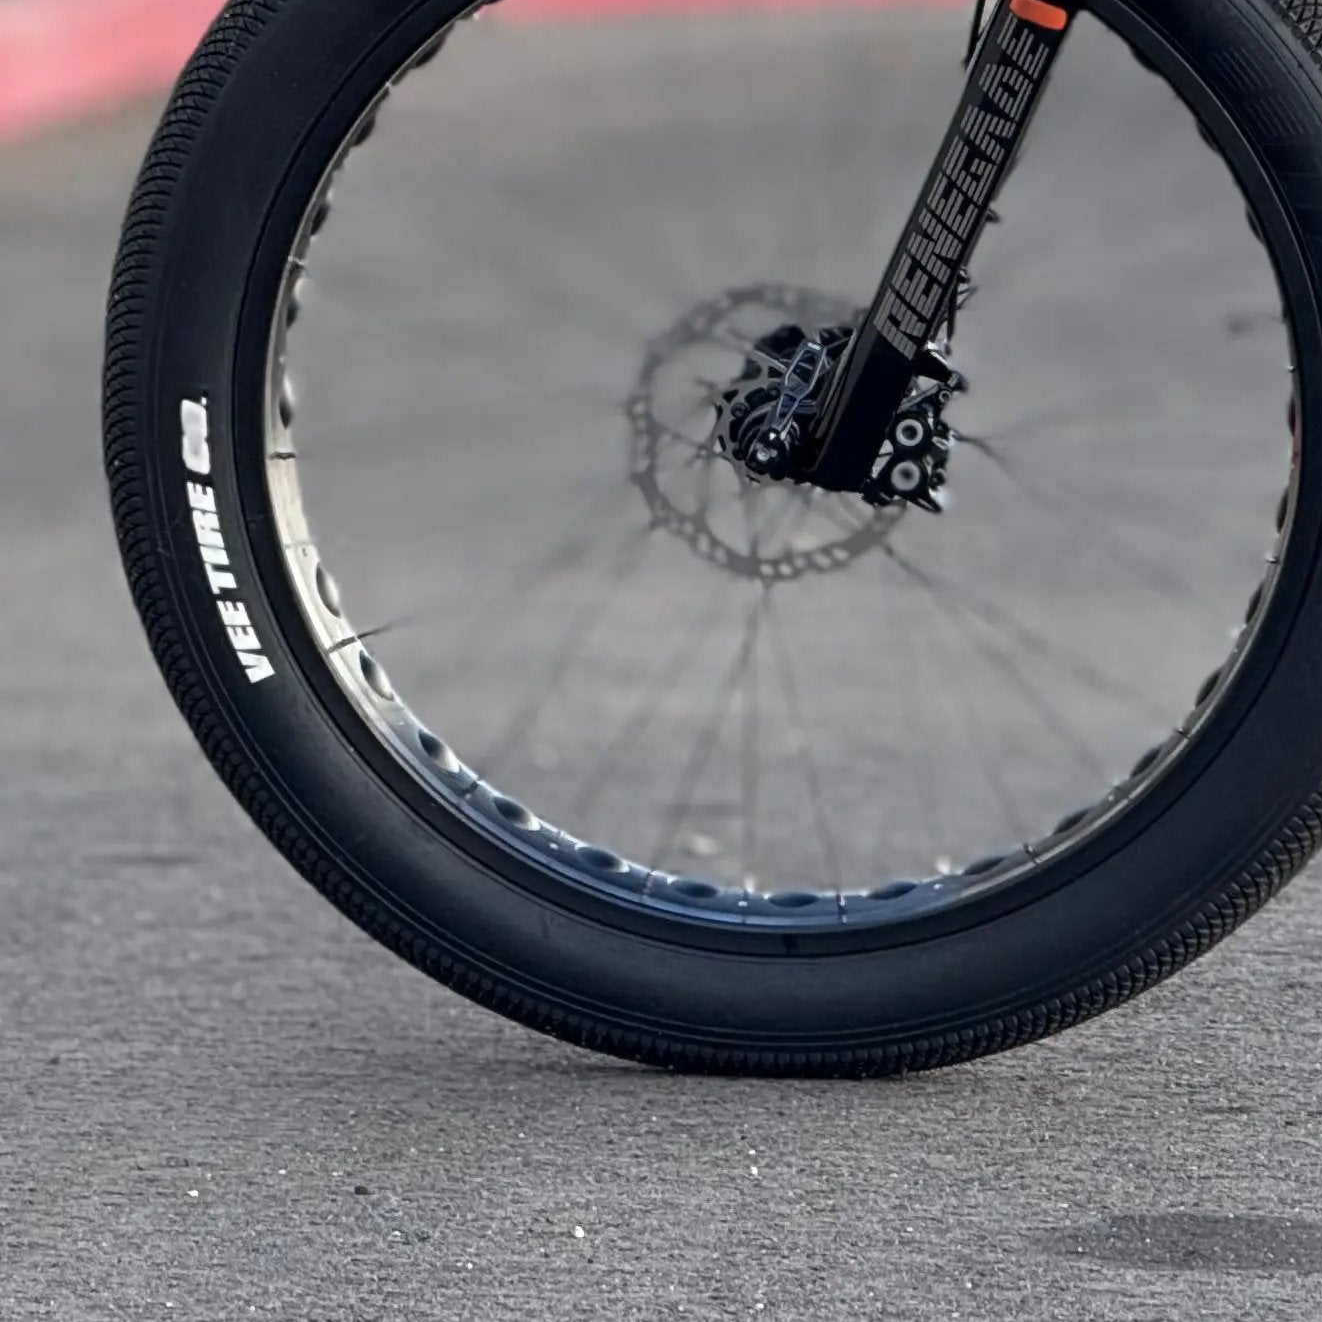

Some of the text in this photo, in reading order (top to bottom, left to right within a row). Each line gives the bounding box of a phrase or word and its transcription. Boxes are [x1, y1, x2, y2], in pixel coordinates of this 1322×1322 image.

[874, 12, 1049, 359] RENEGADE
[187, 481, 238, 594] TIRE
[215, 600, 275, 684] VEE
